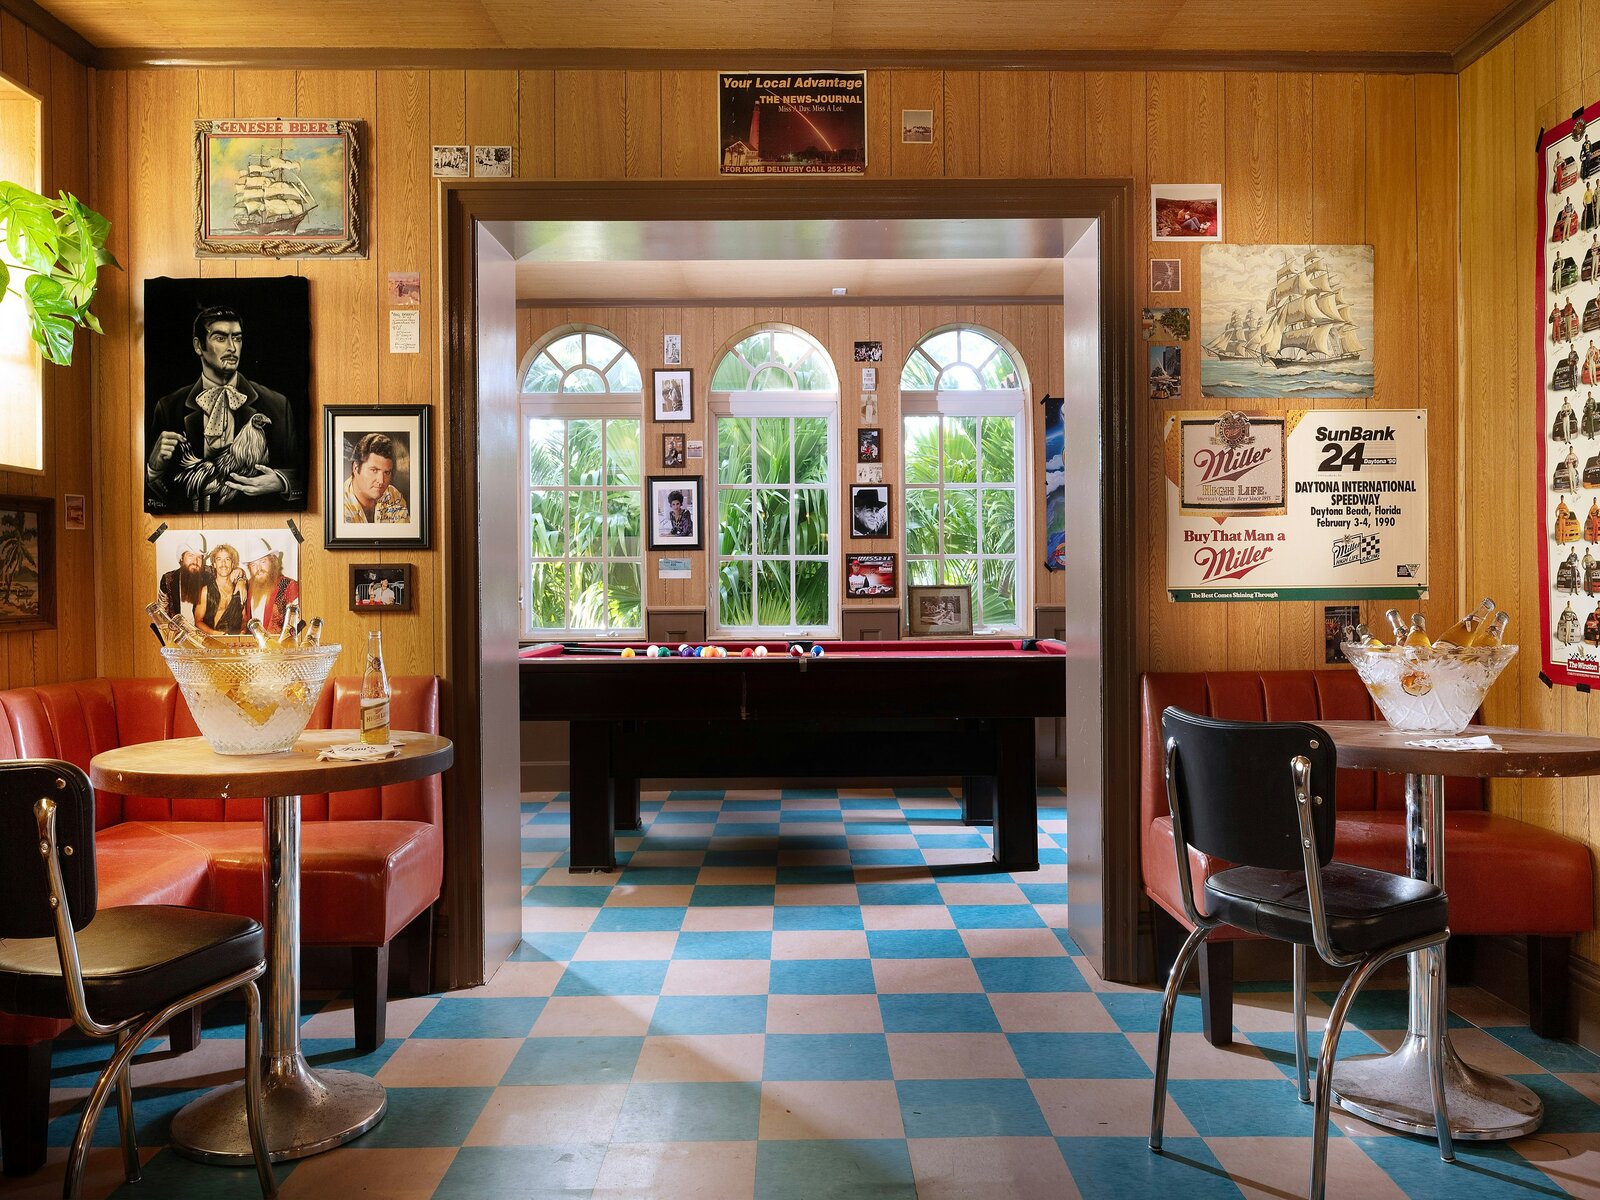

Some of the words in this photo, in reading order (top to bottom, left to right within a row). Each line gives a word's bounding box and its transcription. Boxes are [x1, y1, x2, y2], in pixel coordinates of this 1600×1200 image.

[723, 77, 752, 89] Your
[755, 77, 791, 89] Local
[794, 77, 863, 90] Advantage
[759, 95, 780, 104] THE
[782, 94, 863, 104] NEWS-JOURNAL
[778, 105, 792, 113] Miss
[812, 104, 826, 112] Miss
[832, 104, 844, 112] Lot.
[219, 122, 283, 133] GENESEE
[289, 122, 328, 133] BEER
[725, 166, 741, 174] FOR
[742, 166, 765, 174] HOME
[767, 165, 803, 174] DELIVERY
[806, 165, 825, 174] CALL
[1315, 426, 1396, 441] SunBank
[1317, 442, 1365, 472] 24
[1193, 446, 1272, 482] Miller
[1295, 481, 1340, 493] DAYTONA
[1341, 480, 1416, 493] INTERNATIONAL
[1331, 494, 1380, 506] SPEEDWAY
[1310, 506, 1343, 518] Daytona
[1346, 506, 1371, 516] Beach,
[1374, 505, 1402, 515] Florida
[1317, 518, 1351, 530] February
[1354, 518, 1371, 529] 3-4,
[1375, 518, 1396, 527] 1990
[1184, 530, 1210, 544] Buy
[1211, 530, 1242, 542] That
[1244, 529, 1274, 541] Man
[1277, 532, 1285, 541] a
[1194, 545, 1273, 580] Miller
